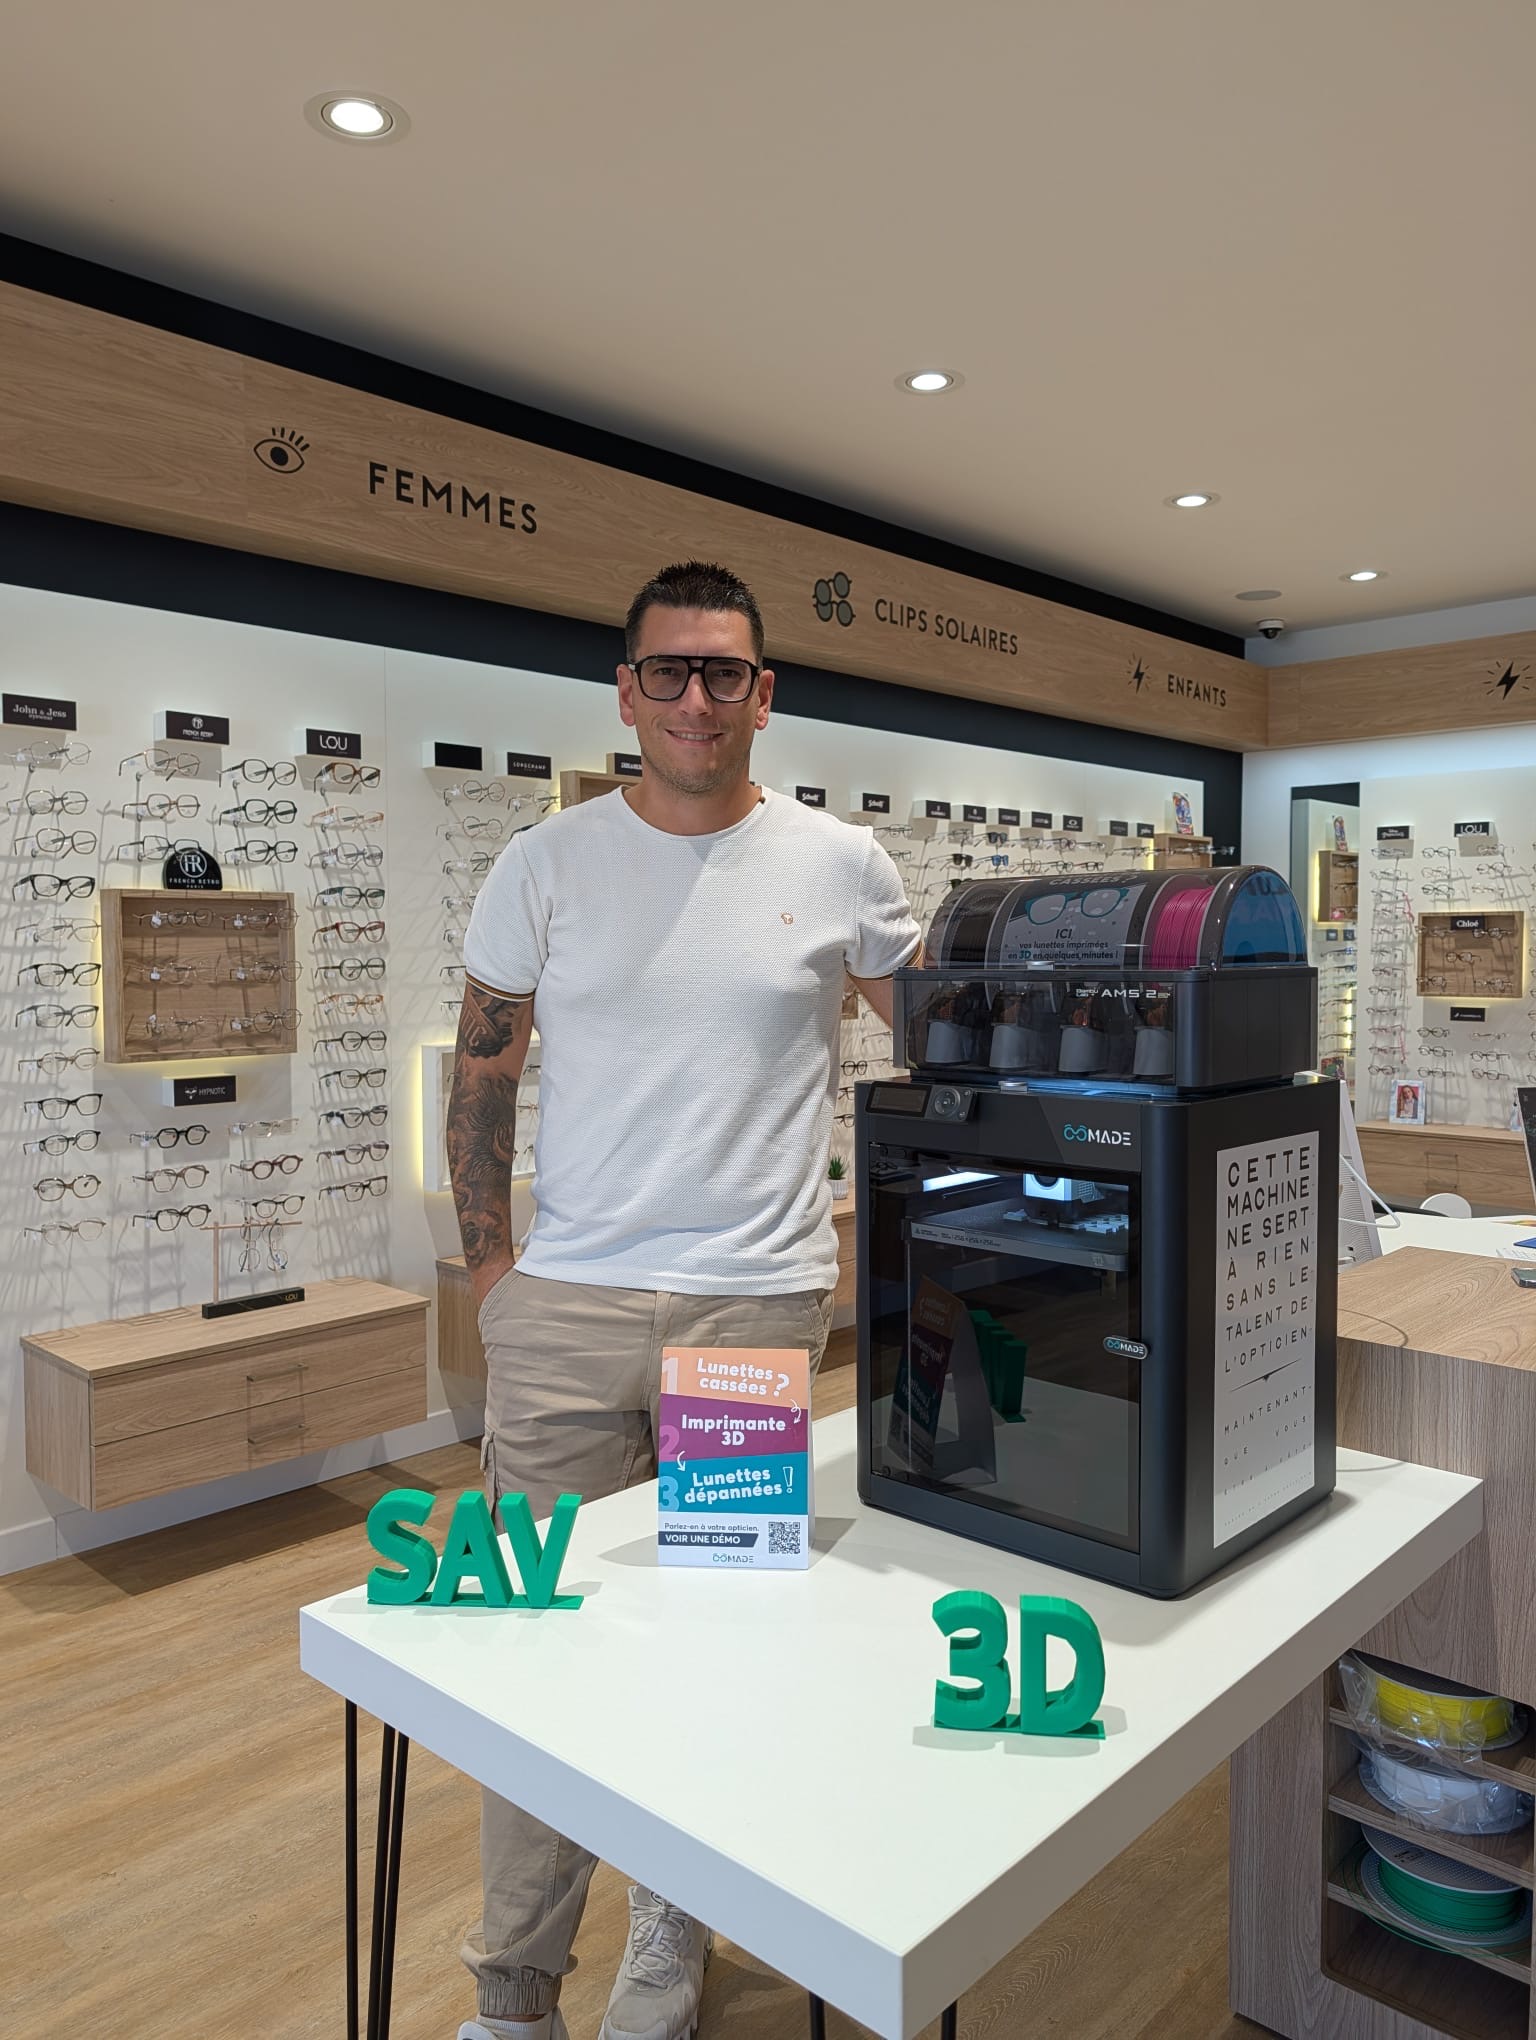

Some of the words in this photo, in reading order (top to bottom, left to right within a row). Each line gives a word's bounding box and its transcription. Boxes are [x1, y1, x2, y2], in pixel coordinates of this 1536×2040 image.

[369, 461, 537, 534] FEMMES
[875, 599, 927, 632] CLIPS
[935, 614, 1018, 655] SOLAIRES
[1168, 674, 1226, 707] ENFANTS
[13, 704, 37, 715] John
[46, 708, 67, 718] Jess
[320, 734, 348, 750] LOU
[1460, 824, 1483, 834] LOU
[1456, 920, 1479, 928] Chloé
[1019, 951, 1031, 959] 3D
[1044, 951, 1079, 960] quelques
[1081, 951, 1114, 959] minutes
[1033, 941, 1065, 949] lunettes
[1067, 941, 1109, 951] imprimées
[1101, 989, 1140, 998] AMS
[1146, 989, 1157, 998] 2
[1228, 1146, 1310, 1187] CETTE
[1227, 1176, 1310, 1218] MACHINE
[1227, 1222, 1252, 1250] NE
[1262, 1206, 1309, 1238] SERT
[1227, 1257, 1237, 1280] À
[1257, 1236, 1309, 1270] RIEN
[1226, 1278, 1276, 1311] SANS
[1289, 1266, 1308, 1287] LE
[1226, 1306, 1282, 1341] TALENT
[1291, 1296, 1308, 1315] DE
[1225, 1326, 1307, 1373] L'OPTICIEN
[697, 1357, 773, 1380] Lunettes
[700, 1377, 768, 1396] cassées
[773, 1373, 790, 1397] ?
[1224, 1386, 1306, 1436] MAINTENANT
[681, 1414, 786, 1433] Imprimante
[721, 1431, 745, 1446] 3D
[692, 1468, 771, 1487] Lunettes
[684, 1482, 783, 1504] dépannées
[664, 1522, 699, 1530] Parlez-en
[366, 1488, 584, 1609] SAV
[665, 1534, 688, 1543] VOIR
[690, 1535, 710, 1544] UNE
[712, 1533, 741, 1544] DÉMO
[932, 1589, 1106, 1739] 3D
